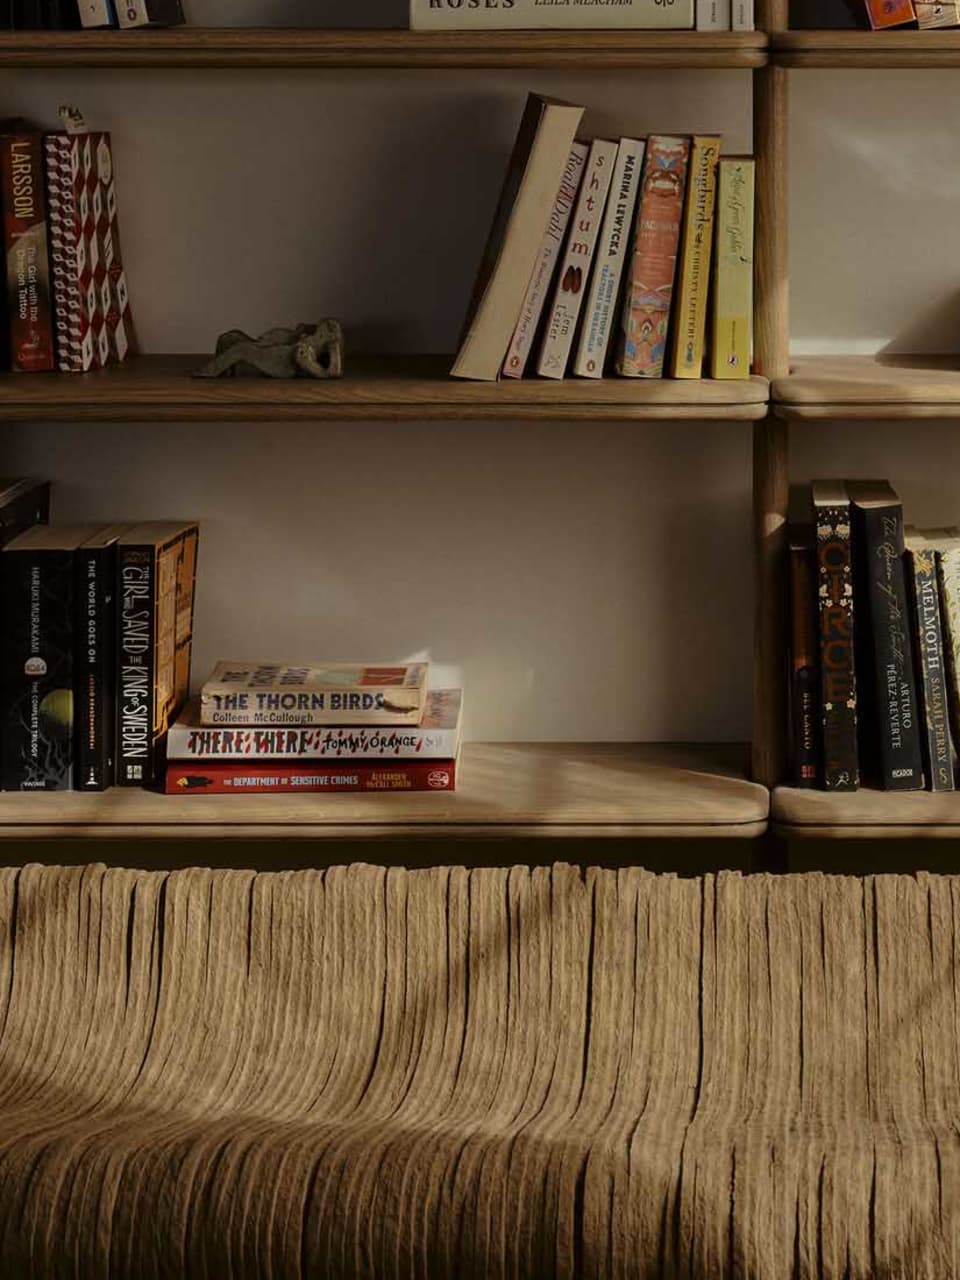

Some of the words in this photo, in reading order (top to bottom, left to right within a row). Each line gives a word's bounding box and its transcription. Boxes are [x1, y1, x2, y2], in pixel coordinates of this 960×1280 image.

[11, 140, 35, 220] LARSSON
[620, 154, 636, 199] MARINA
[694, 146, 714, 231] Songbirds
[607, 200, 628, 258] LEWYCKA
[19, 287, 28, 320] Tattoo
[30, 566, 41, 600] HARUKI
[87, 559, 97, 579] THE
[121, 566, 150, 600] GIRL
[87, 581, 97, 618] WORLD
[30, 601, 41, 654] MURAKAMI
[87, 619, 97, 647] GOES
[121, 610, 150, 655] SAVED
[920, 579, 940, 670] MELMOTH
[87, 648, 97, 664] ON
[121, 664, 150, 698] KING
[931, 675, 944, 720] SARAH
[31, 694, 40, 729] COMPLETE
[212, 694, 250, 711] THE
[256, 693, 324, 711] THORN
[330, 692, 385, 710] BIRDS
[212, 712, 250, 723] Colleen
[254, 712, 314, 726] McCullough
[899, 681, 913, 730] ARTURO
[121, 705, 150, 759] SWEDEN
[188, 731, 245, 755] THERE
[254, 730, 309, 755] THERE
[370, 735, 418, 749] ORANGE
[935, 722, 948, 762] PERRY
[233, 776, 280, 787] DEPARTMENT
[290, 775, 328, 787] SENSITIVE
[330, 775, 359, 786] CRIMES
[370, 771, 407, 781] ALEXANDER
